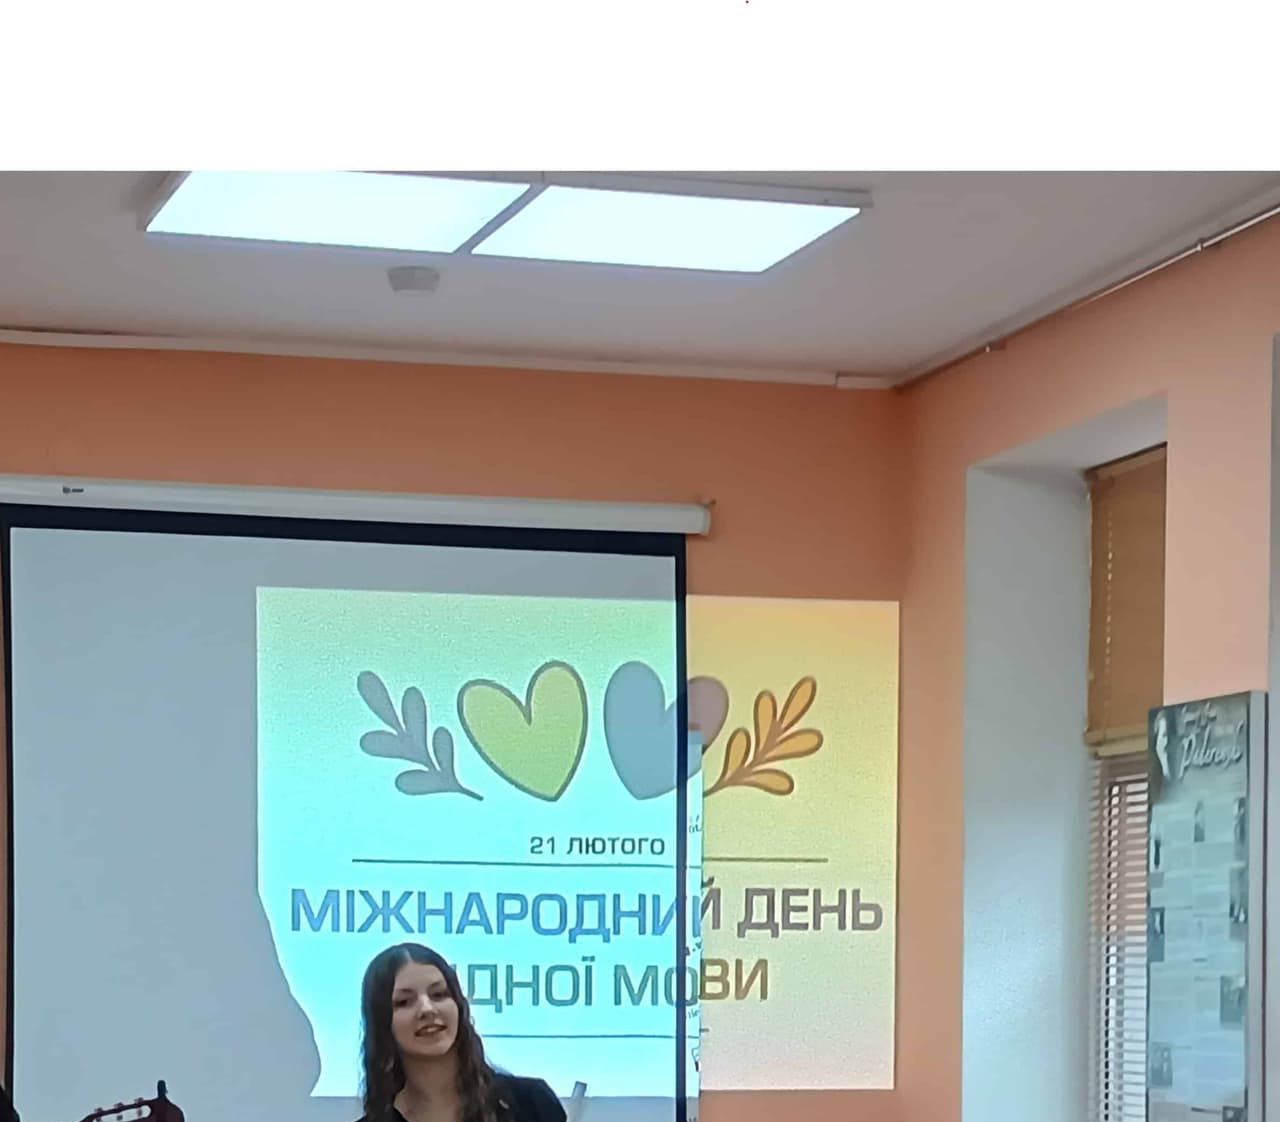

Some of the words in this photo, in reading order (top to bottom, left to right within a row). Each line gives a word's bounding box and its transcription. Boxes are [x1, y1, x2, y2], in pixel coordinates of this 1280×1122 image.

[530, 836, 556, 855] 21
[566, 836, 665, 856] ЛЮТОГО
[290, 876, 720, 944] МІЖНАРОДНИЙ
[736, 887, 884, 939] ДЕНЬ
[453, 956, 594, 1013] ДНОЇ
[613, 958, 769, 1007] МОВИ
